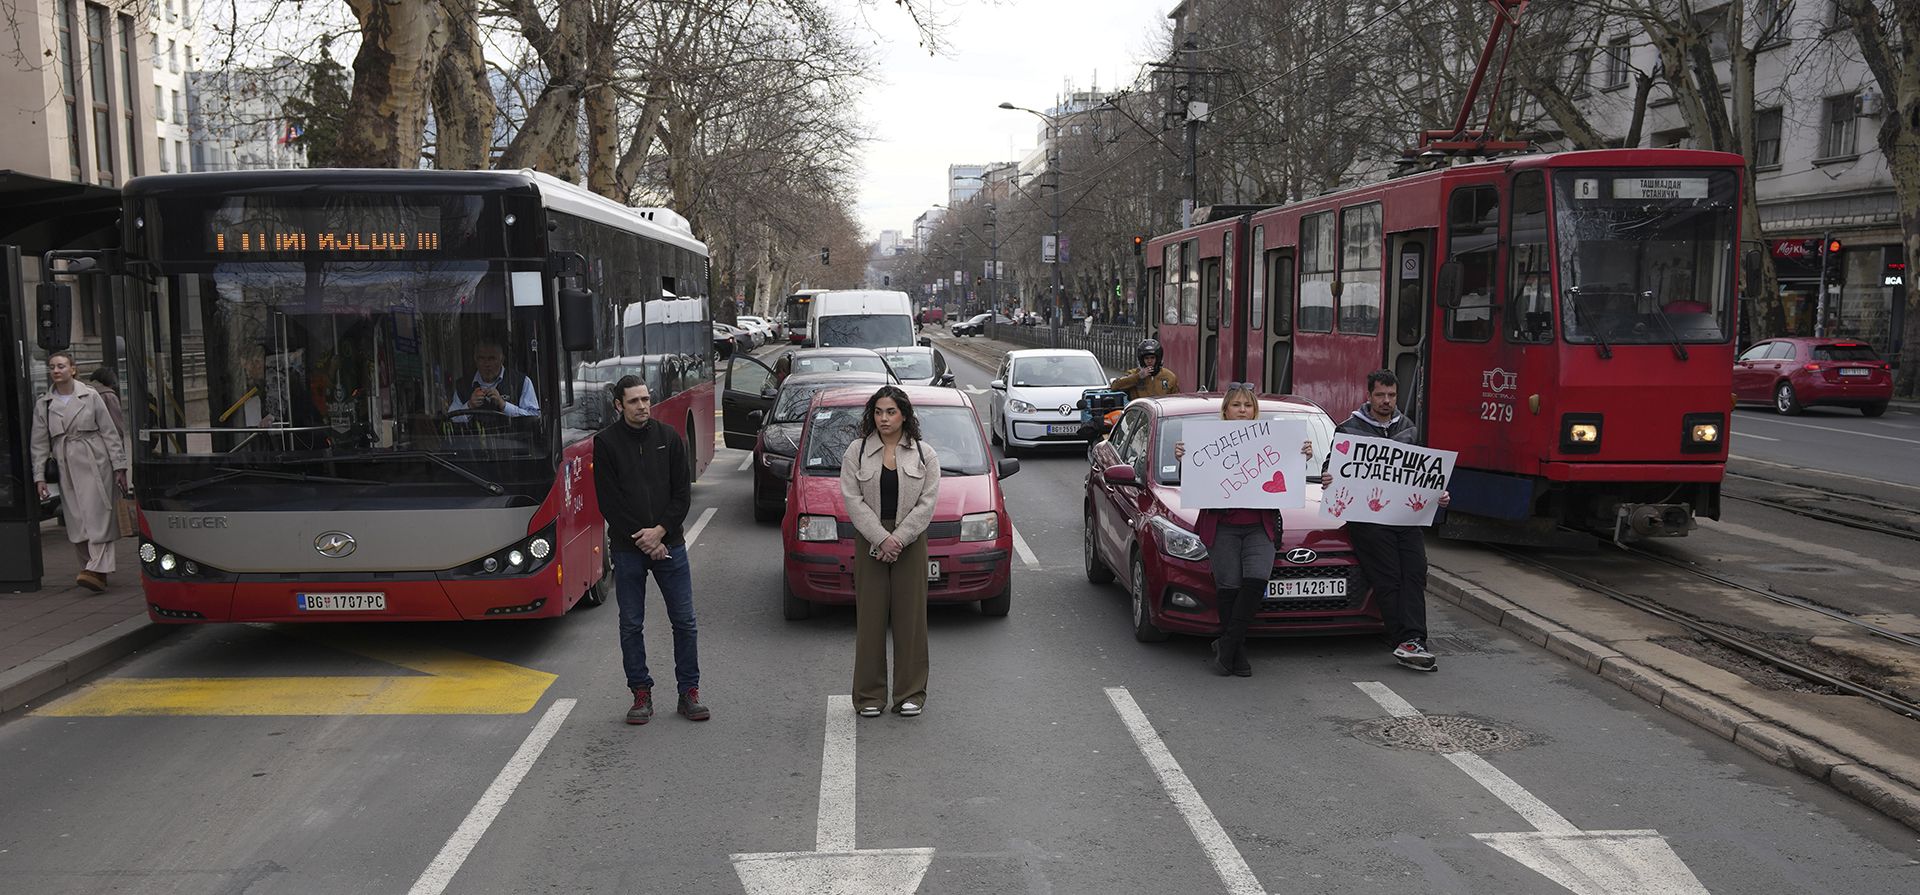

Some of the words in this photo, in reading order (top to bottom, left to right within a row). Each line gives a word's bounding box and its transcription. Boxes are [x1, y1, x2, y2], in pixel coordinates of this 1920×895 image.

[1582, 182, 1589, 195] 6
[1640, 180, 1682, 189] ТАШМАЈДАН
[1481, 402, 1513, 422] 2279
[1192, 421, 1271, 467] СТУДЕНТИ
[1222, 450, 1240, 470] СУ
[1353, 442, 1443, 474] ПОДРШКА
[1220, 445, 1281, 499] ЉУБАВ
[1340, 461, 1446, 491] СТУДЕНТИМА
[168, 515, 229, 529] HIGER
[1269, 582, 1285, 596] BG
[307, 596, 323, 609] BG
